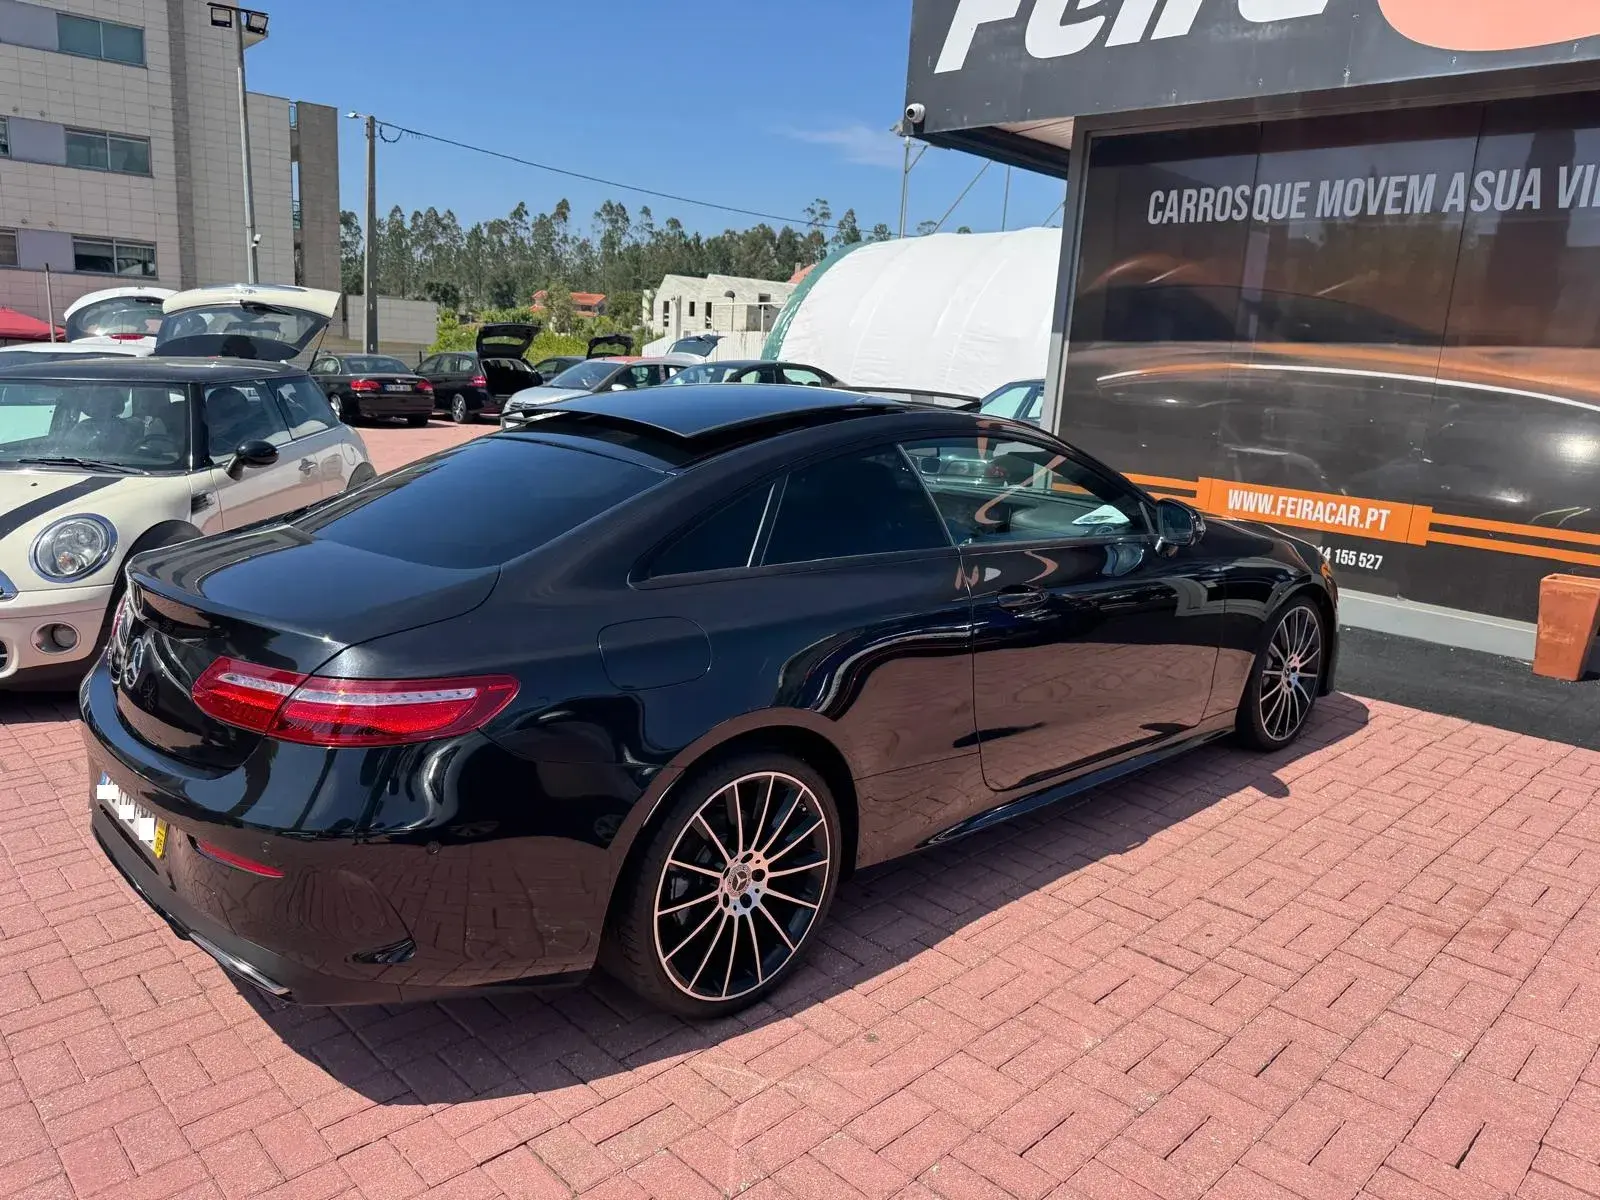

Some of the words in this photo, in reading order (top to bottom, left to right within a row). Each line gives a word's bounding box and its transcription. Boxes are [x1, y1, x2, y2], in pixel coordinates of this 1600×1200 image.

[1147, 184, 1251, 224] CARROS
[1251, 180, 1311, 223] QUE
[1315, 173, 1437, 216] MOVEM
[1441, 171, 1465, 213] A
[1470, 167, 1541, 212] SUA
[1228, 489, 1391, 531] WWW.FEIRACAR.PT
[1334, 548, 1357, 566] 155
[1358, 552, 1383, 570] 527
